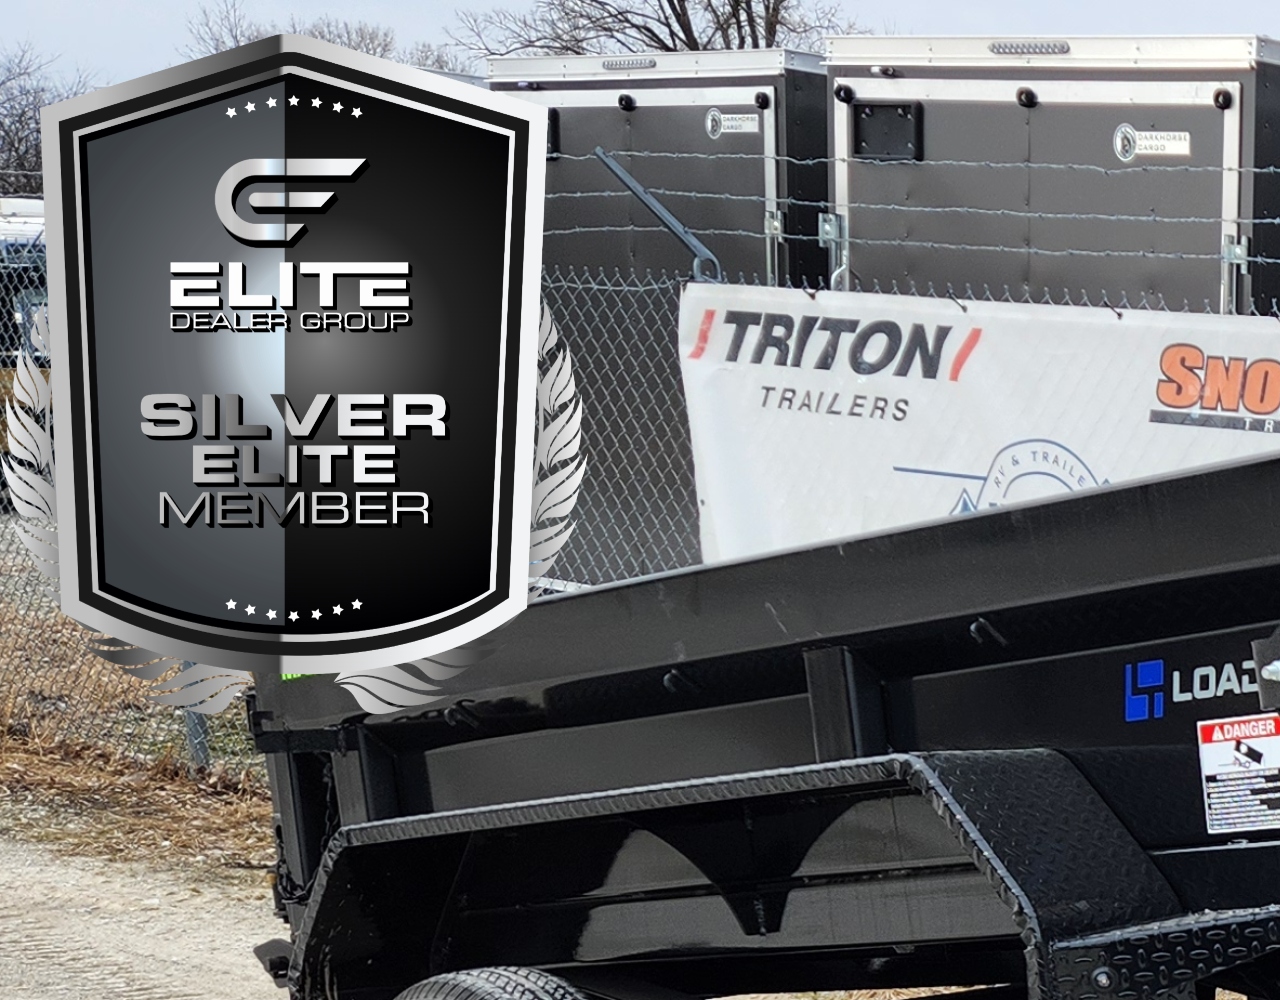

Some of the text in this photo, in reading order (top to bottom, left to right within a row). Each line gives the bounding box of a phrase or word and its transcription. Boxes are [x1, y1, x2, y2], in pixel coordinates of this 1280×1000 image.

[723, 310, 953, 380] TRITON
[760, 386, 910, 421] TRAILERS
[1030, 450, 1085, 487] TRAILE
[1223, 719, 1276, 739] DANGER
